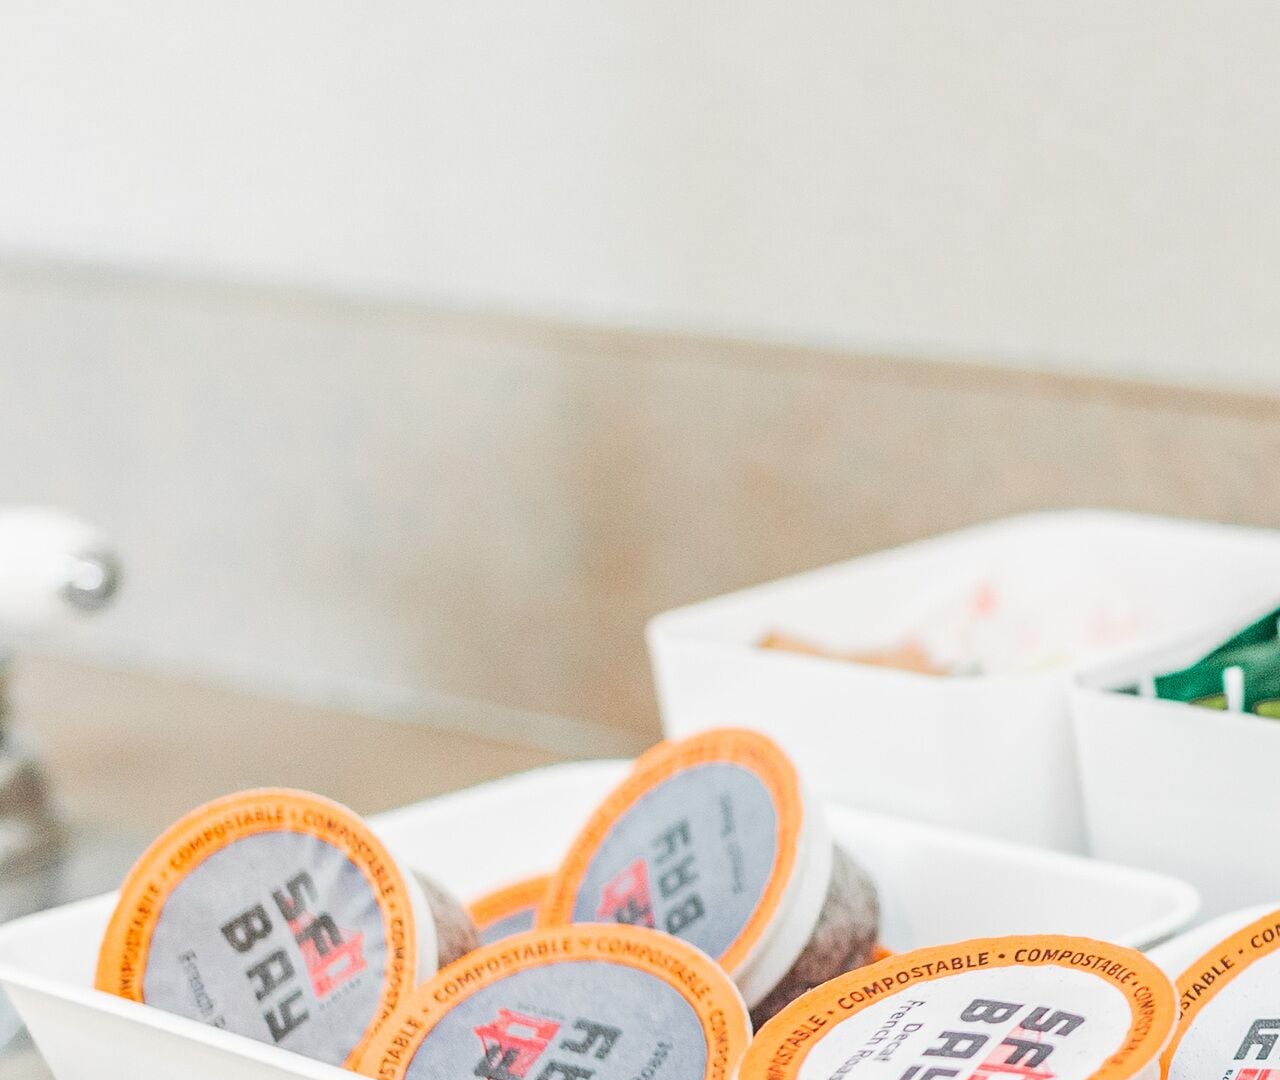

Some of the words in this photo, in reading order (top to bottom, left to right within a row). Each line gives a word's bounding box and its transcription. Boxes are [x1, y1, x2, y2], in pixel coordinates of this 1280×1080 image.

[650, 815, 706, 936] BAY
[271, 870, 347, 957] SF
[219, 903, 311, 1043] BAY
[432, 936, 574, 1001] COMPOSTABLE
[837, 951, 990, 1011] COMPOSTABLE
[1013, 947, 1137, 984] COMPOSTABLE
[1178, 954, 1236, 1021] STABLE
[869, 999, 926, 1053] French
[879, 1021, 924, 1062] Decaf
[997, 1005, 1086, 1069] SF
